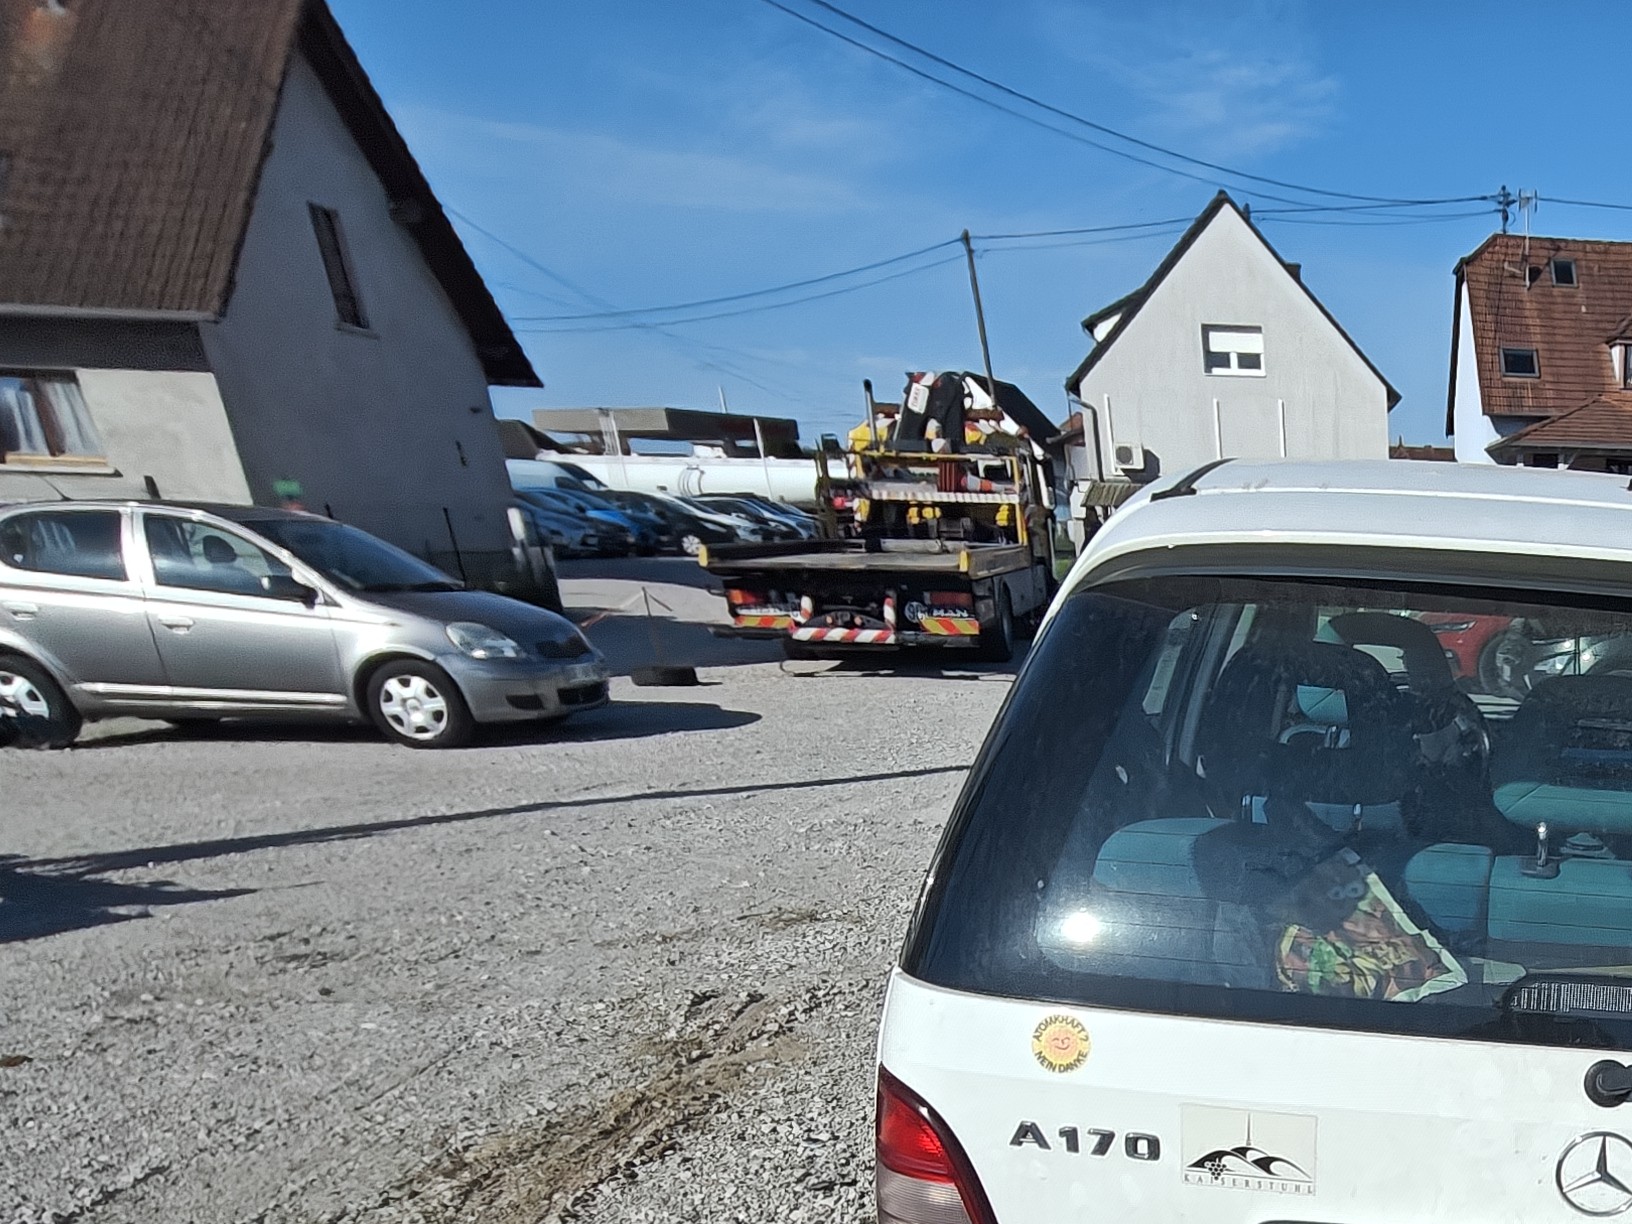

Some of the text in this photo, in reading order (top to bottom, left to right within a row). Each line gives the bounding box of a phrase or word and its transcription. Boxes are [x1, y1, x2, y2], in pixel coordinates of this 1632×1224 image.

[1034, 1049, 1089, 1074] NEIN DANKE
[1183, 1173, 1314, 1195] KAISERSTUHL
